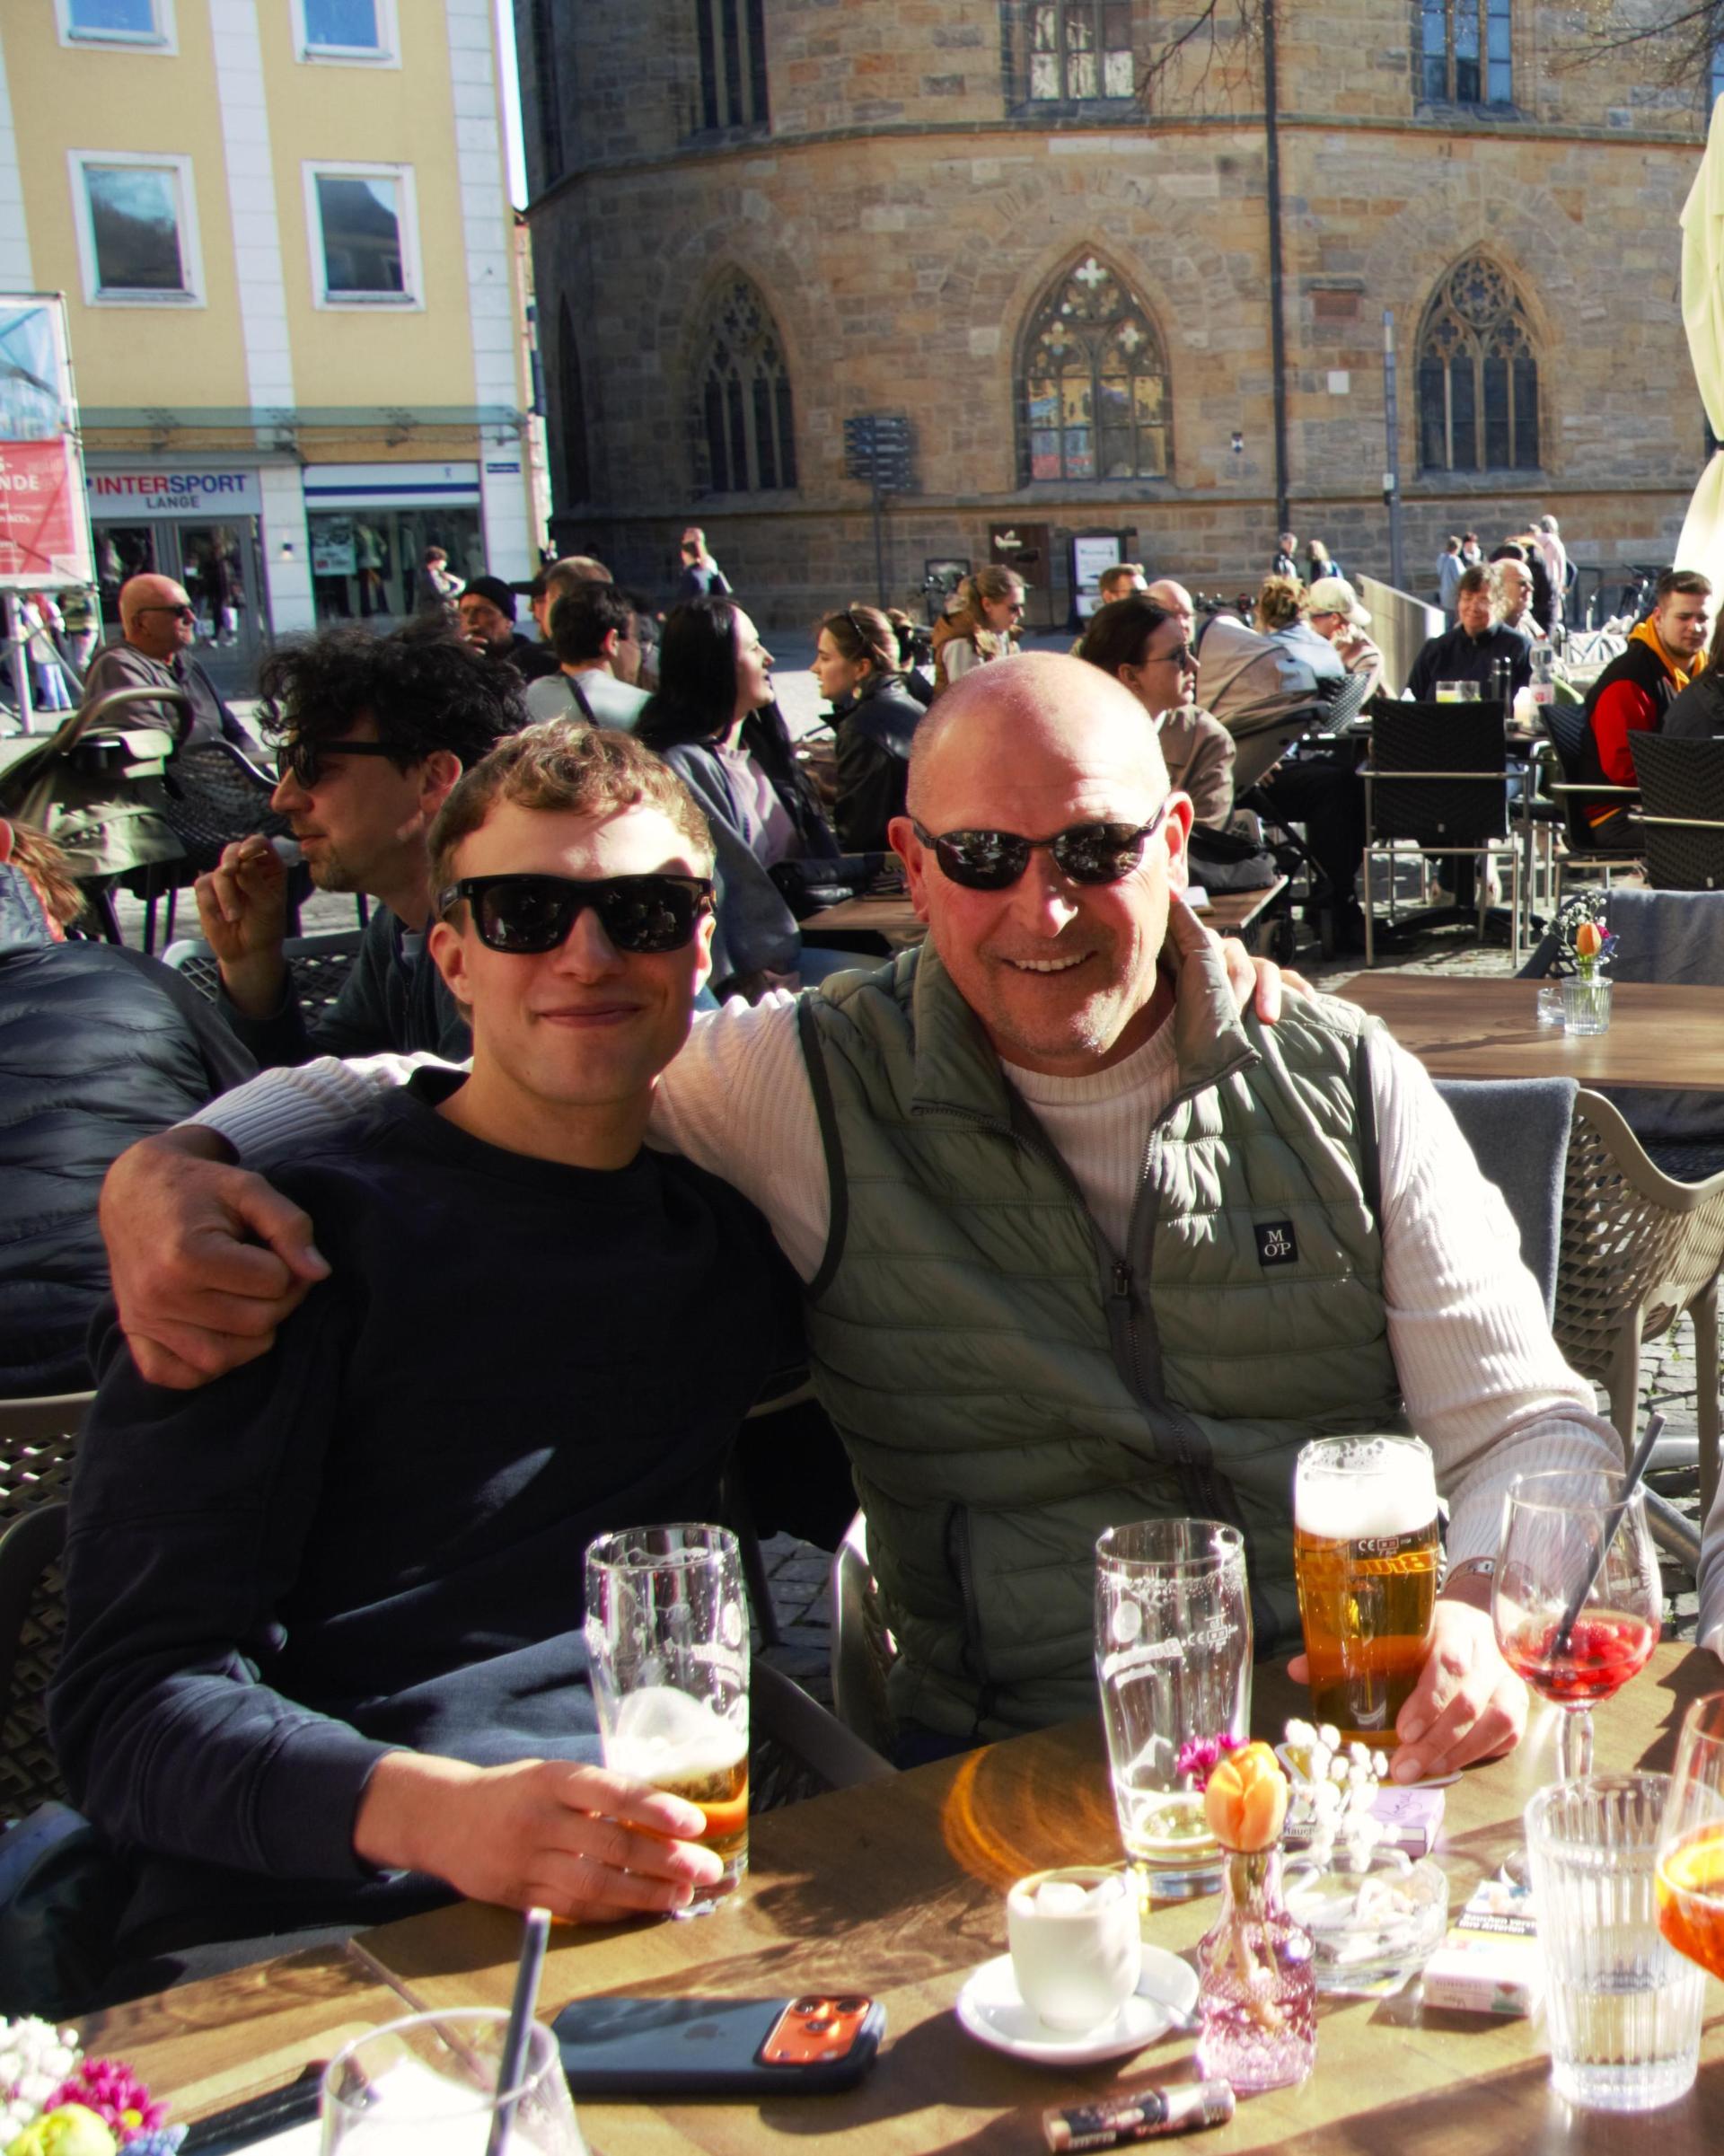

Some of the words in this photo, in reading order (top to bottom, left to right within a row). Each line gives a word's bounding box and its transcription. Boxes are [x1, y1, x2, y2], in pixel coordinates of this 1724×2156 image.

[97, 474, 247, 494] INTERSPORT
[145, 496, 200, 509] LANGE
[1266, 1229, 1284, 1243] M
